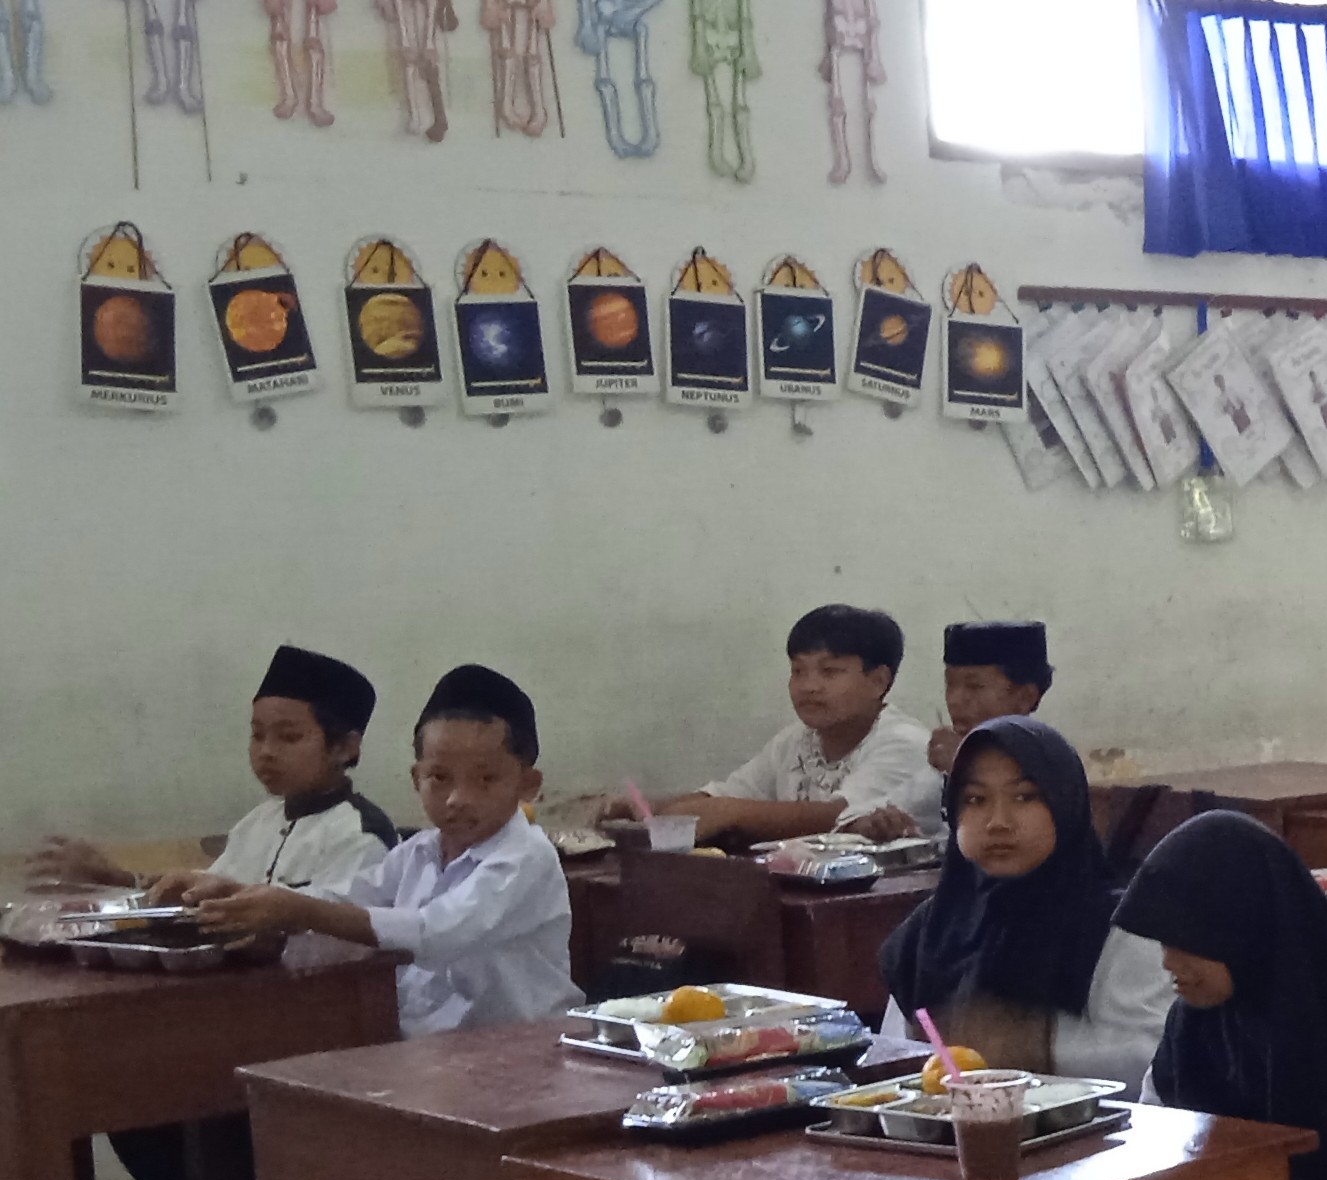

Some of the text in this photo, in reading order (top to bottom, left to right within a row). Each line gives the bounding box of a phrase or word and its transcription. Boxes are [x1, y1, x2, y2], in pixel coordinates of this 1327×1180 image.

[247, 374, 310, 394] MATAHARI
[596, 378, 638, 389] JUPITER
[380, 385, 421, 397] VENUS
[780, 384, 821, 396] URANUS
[90, 389, 168, 406] MERKURIUS
[493, 398, 524, 408] BUMI
[681, 390, 740, 404] NEPTUNUS
[970, 407, 1000, 418] MARS
